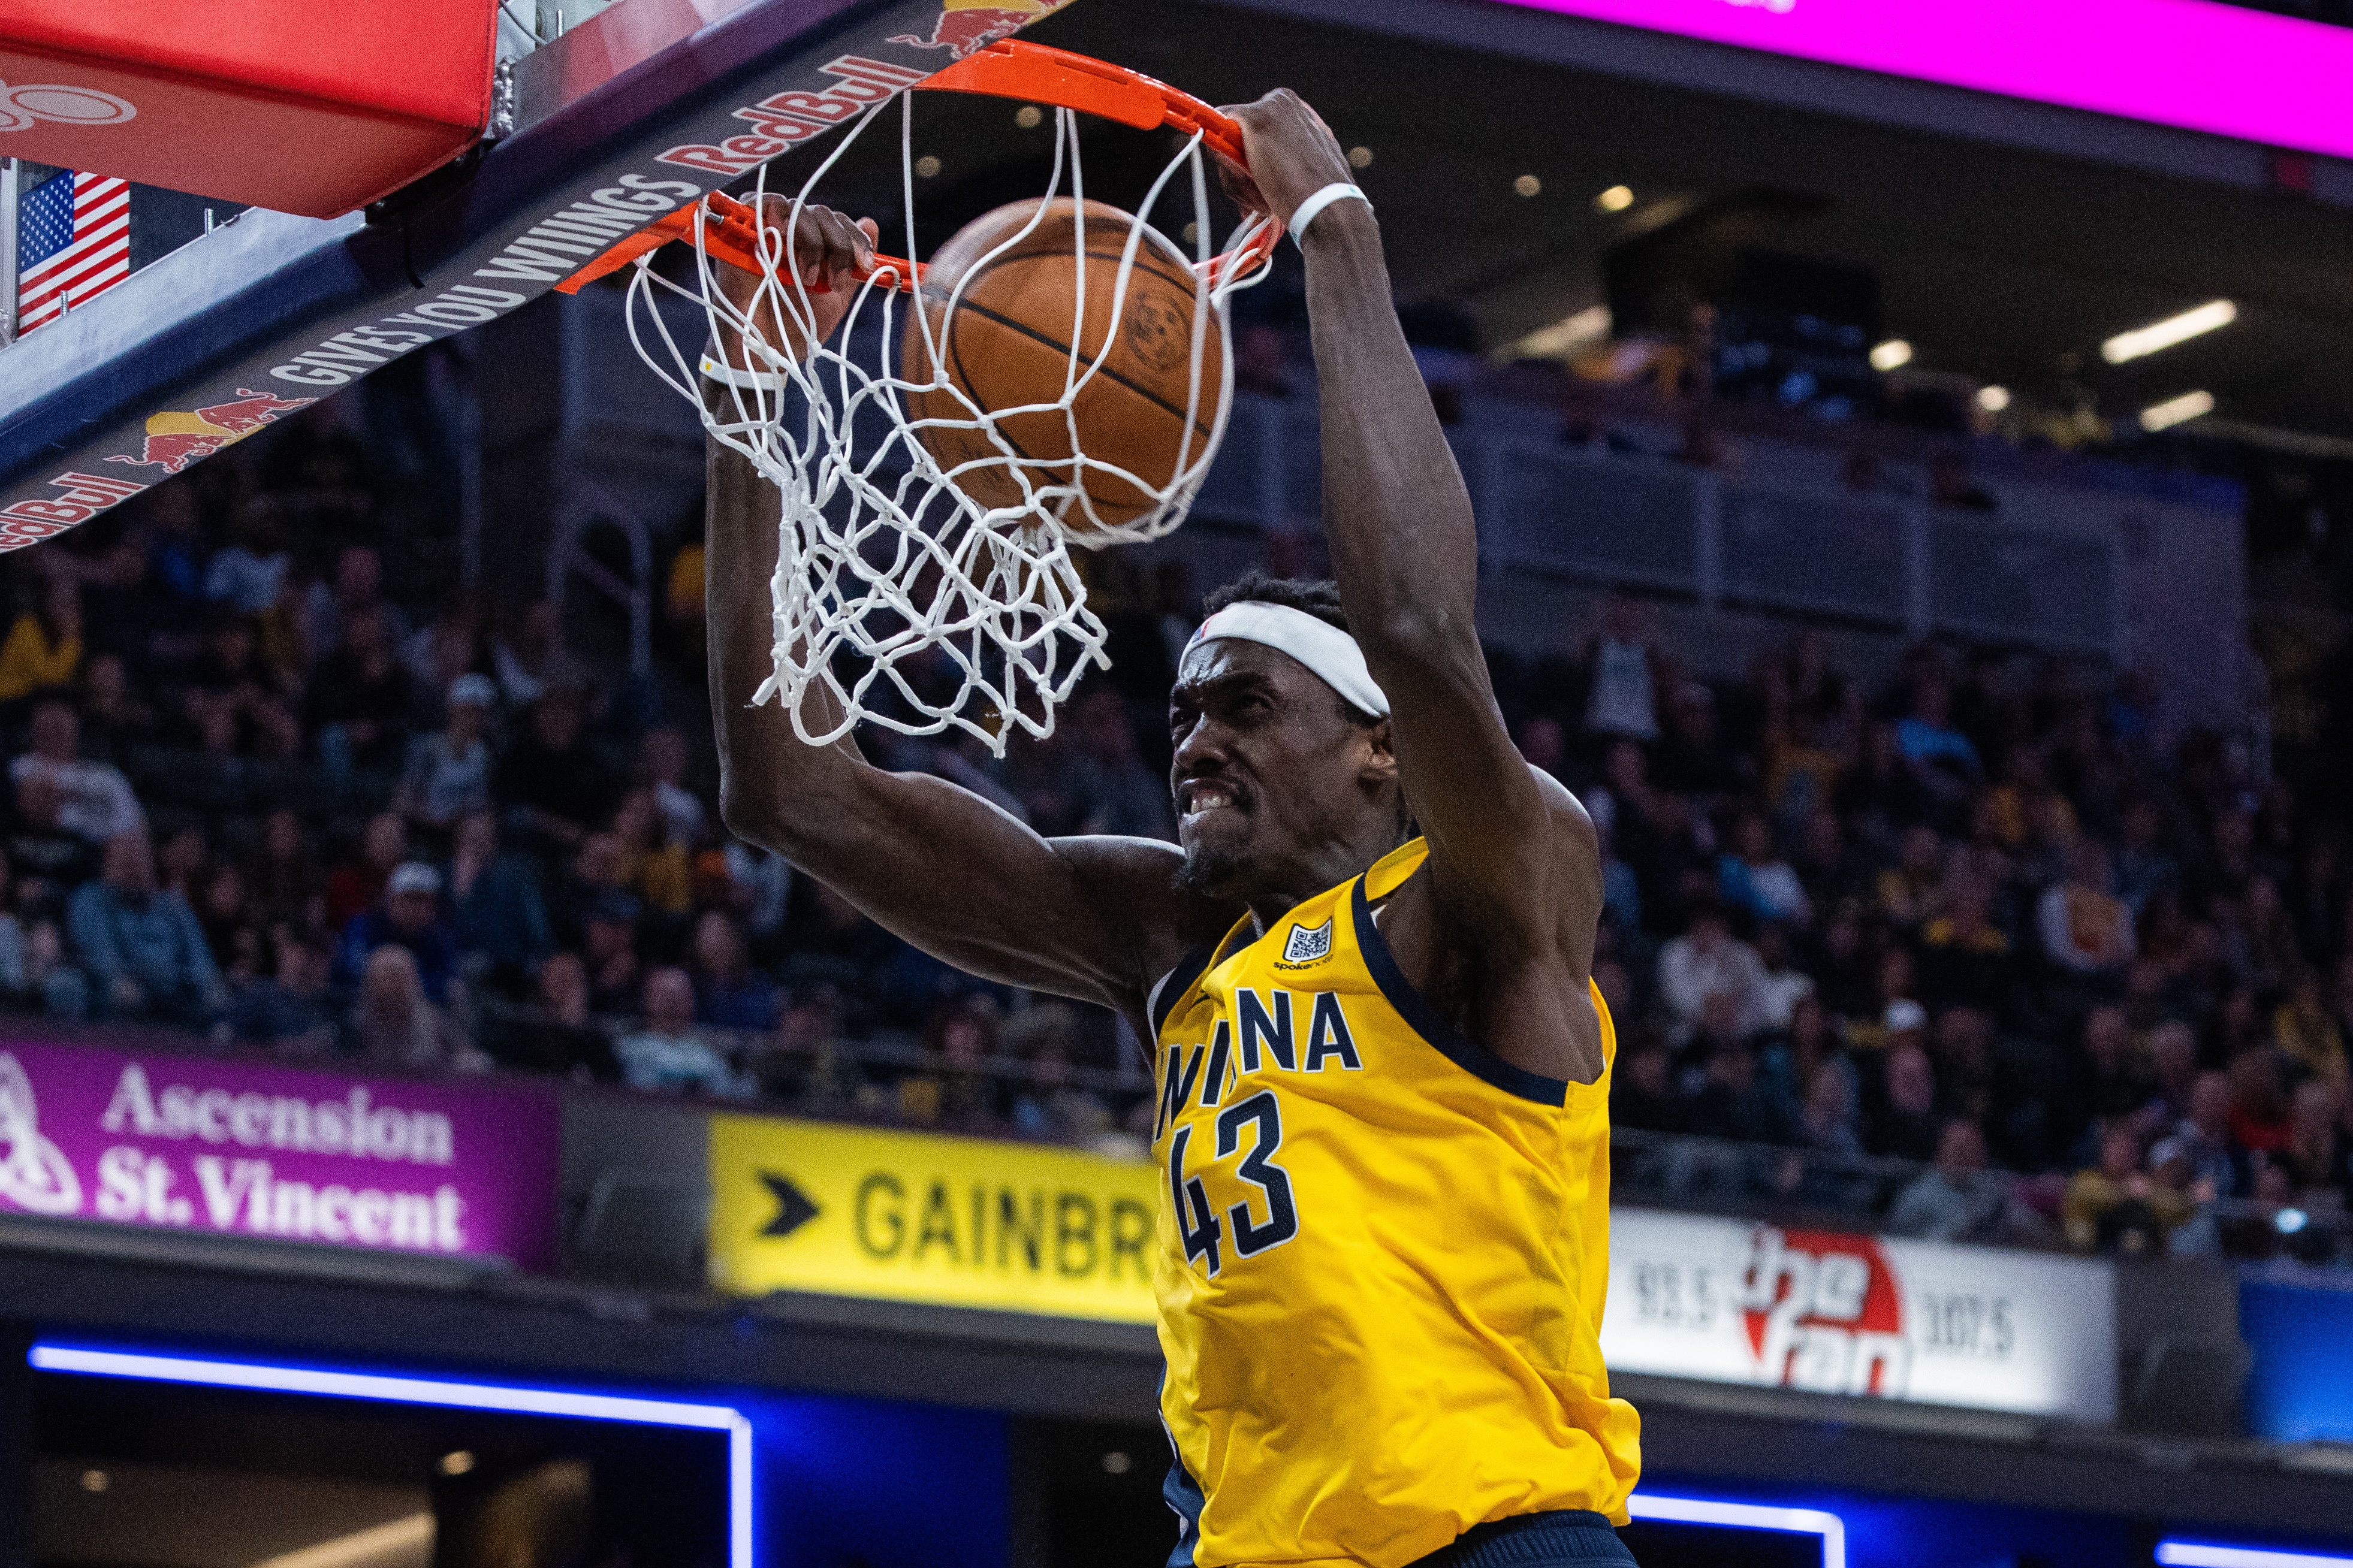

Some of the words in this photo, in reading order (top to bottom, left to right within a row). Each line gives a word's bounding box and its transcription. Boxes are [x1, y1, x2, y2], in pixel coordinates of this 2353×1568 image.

[270, 325, 433, 385] GIVES
[380, 285, 527, 330] YOU
[473, 173, 702, 282] WIIINGS
[102, 1063, 455, 1165] Ascension
[96, 1146, 194, 1226] St.
[195, 1156, 466, 1252] Vincent
[853, 1171, 1156, 1282] GAINBR
[1169, 1088, 1299, 1280] 43
